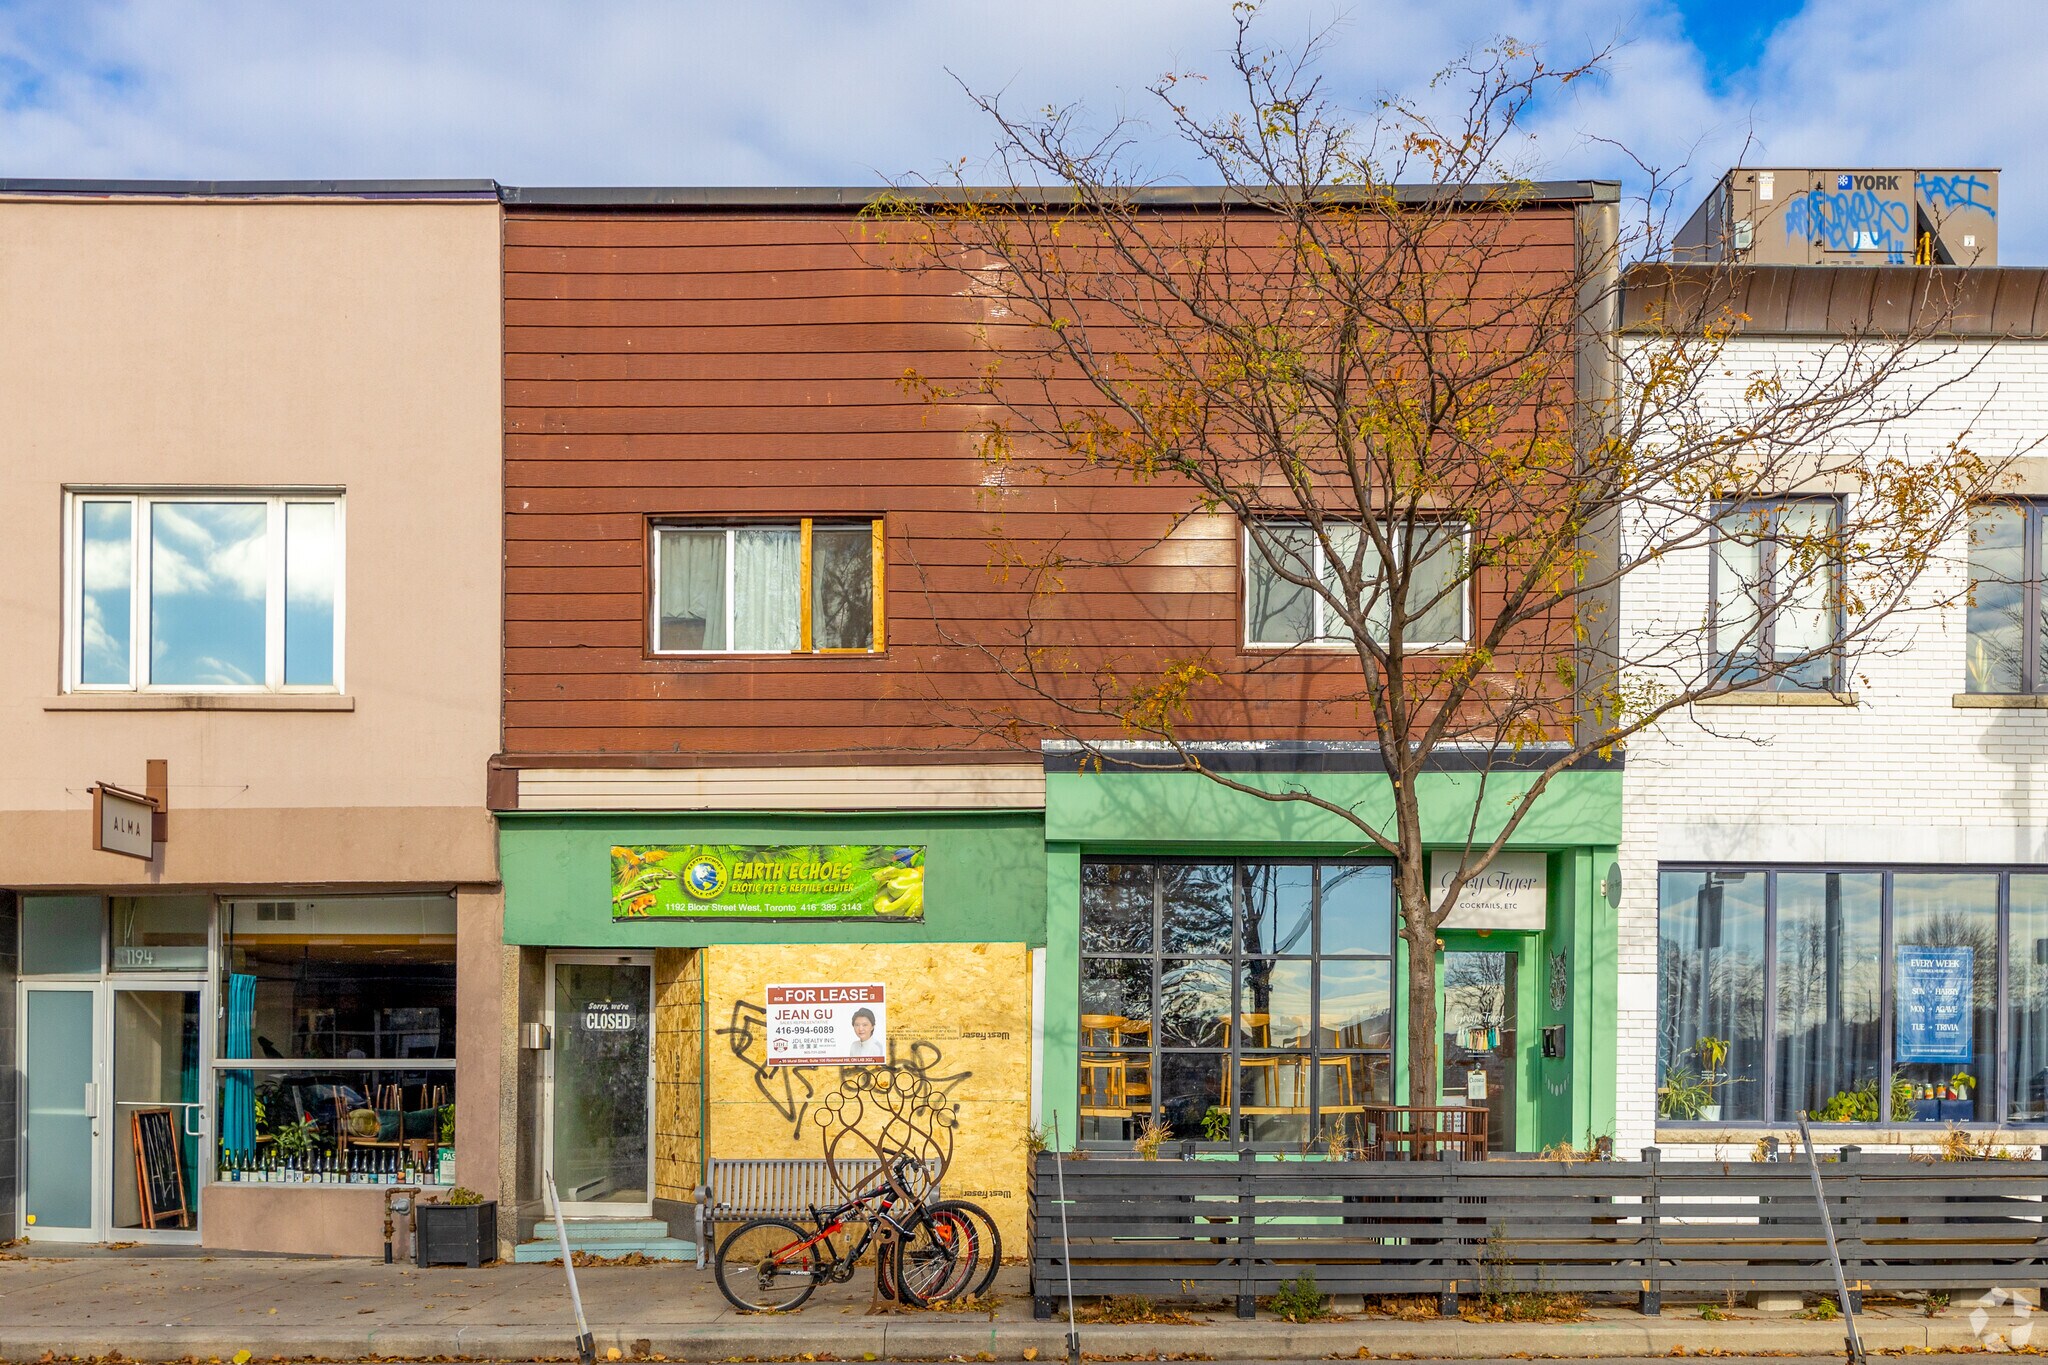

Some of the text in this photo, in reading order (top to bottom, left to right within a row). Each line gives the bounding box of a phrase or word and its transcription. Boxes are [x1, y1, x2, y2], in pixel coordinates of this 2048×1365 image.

[1854, 175, 1899, 190] YORK
[113, 816, 141, 837] ALMA
[732, 861, 853, 880] EARTH ECHOES
[731, 883, 855, 893] EXOTIC PET & REPTILE CENTER
[1441, 870, 1537, 897] Gey Tiger
[665, 903, 687, 912] 1192
[688, 903, 710, 912] Bloor
[711, 903, 738, 912] Street
[738, 903, 763, 914] West,
[765, 903, 797, 913] Toronto
[801, 903, 817, 912] 416
[841, 903, 863, 912] 3143
[1460, 902, 1518, 910] COCKTAILS, ETC
[126, 949, 153, 965] 1194
[1910, 959, 1960, 968] EVERY WEEK
[785, 989, 817, 1002] FOR
[820, 988, 869, 1001] LEASE
[1911, 987, 1959, 995] SUN HARRY
[588, 1002, 609, 1011] Sorry,
[1910, 1005, 1958, 1013] MON AGAVE
[775, 1009, 833, 1021] JEAN GU
[586, 1012, 631, 1029] CLOSED
[775, 1026, 834, 1034] 416-994-6089
[1911, 1023, 1959, 1031] TUE TRIVIA
[987, 1031, 1010, 1040] West
[989, 1190, 1011, 1199] West
